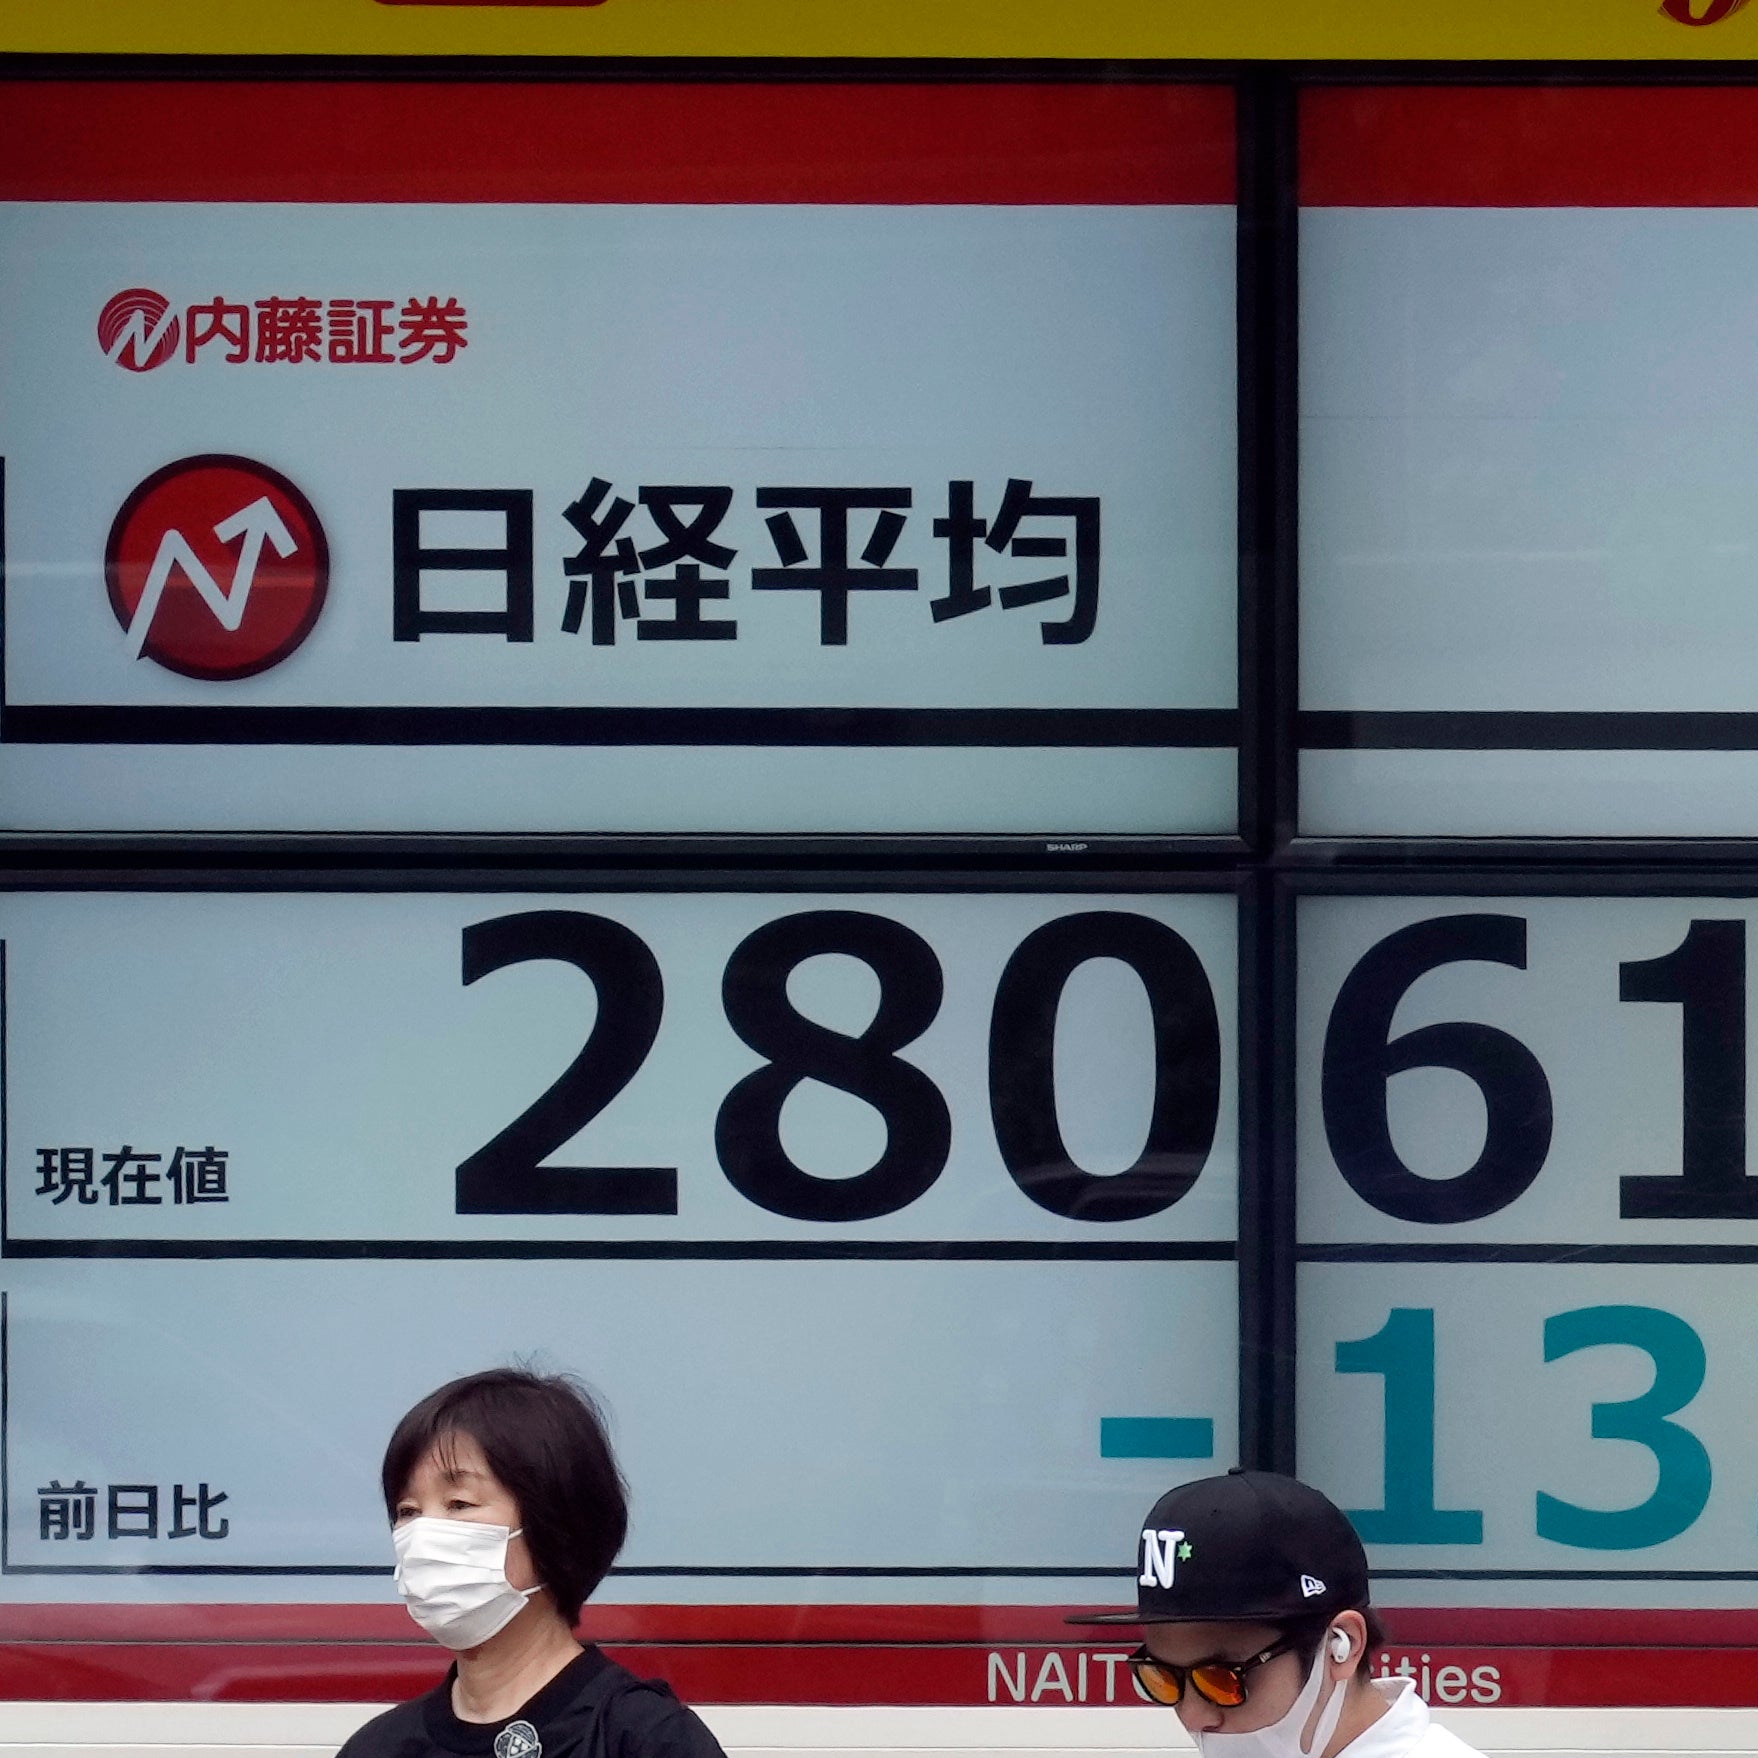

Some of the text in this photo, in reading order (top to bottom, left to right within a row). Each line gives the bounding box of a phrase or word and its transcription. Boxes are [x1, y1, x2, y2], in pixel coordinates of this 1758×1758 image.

[185, 295, 468, 365] 内藤証券
[392, 476, 1102, 646] 日経平均
[34, 1144, 231, 1206] 現在値
[37, 1479, 230, 1541] 前日比
[987, 1651, 1156, 1703] NAIT
